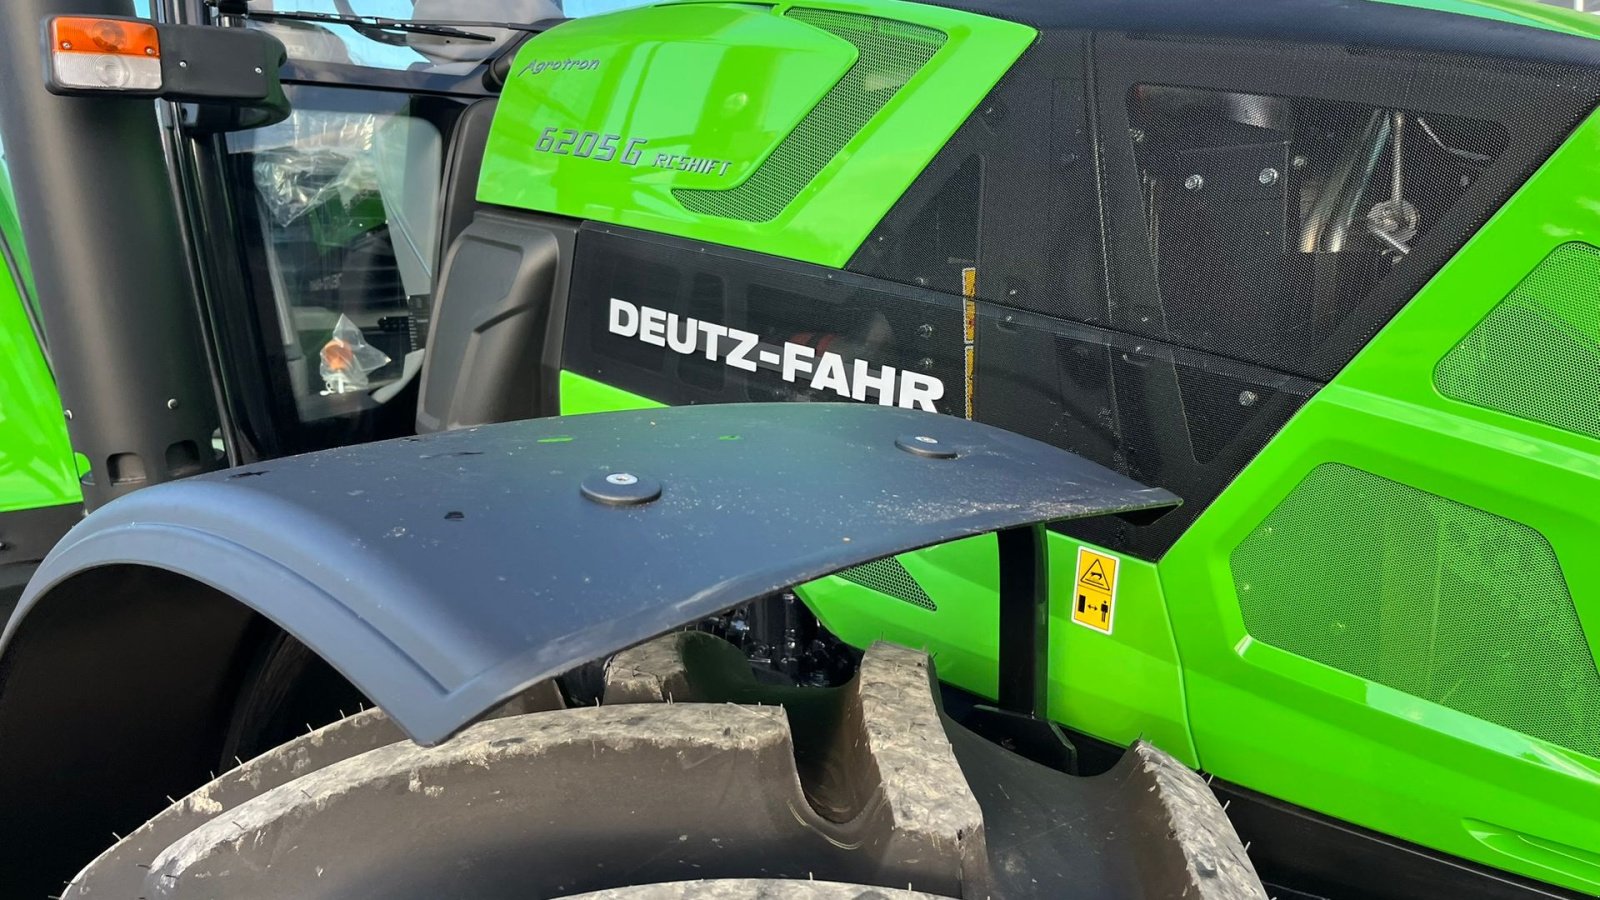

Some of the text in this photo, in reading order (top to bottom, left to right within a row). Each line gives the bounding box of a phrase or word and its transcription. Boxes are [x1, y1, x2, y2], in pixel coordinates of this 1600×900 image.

[517, 58, 600, 77] Agrotron
[651, 153, 732, 176] RCSHIFT
[608, 297, 945, 413] DEUTZ-FAHR
